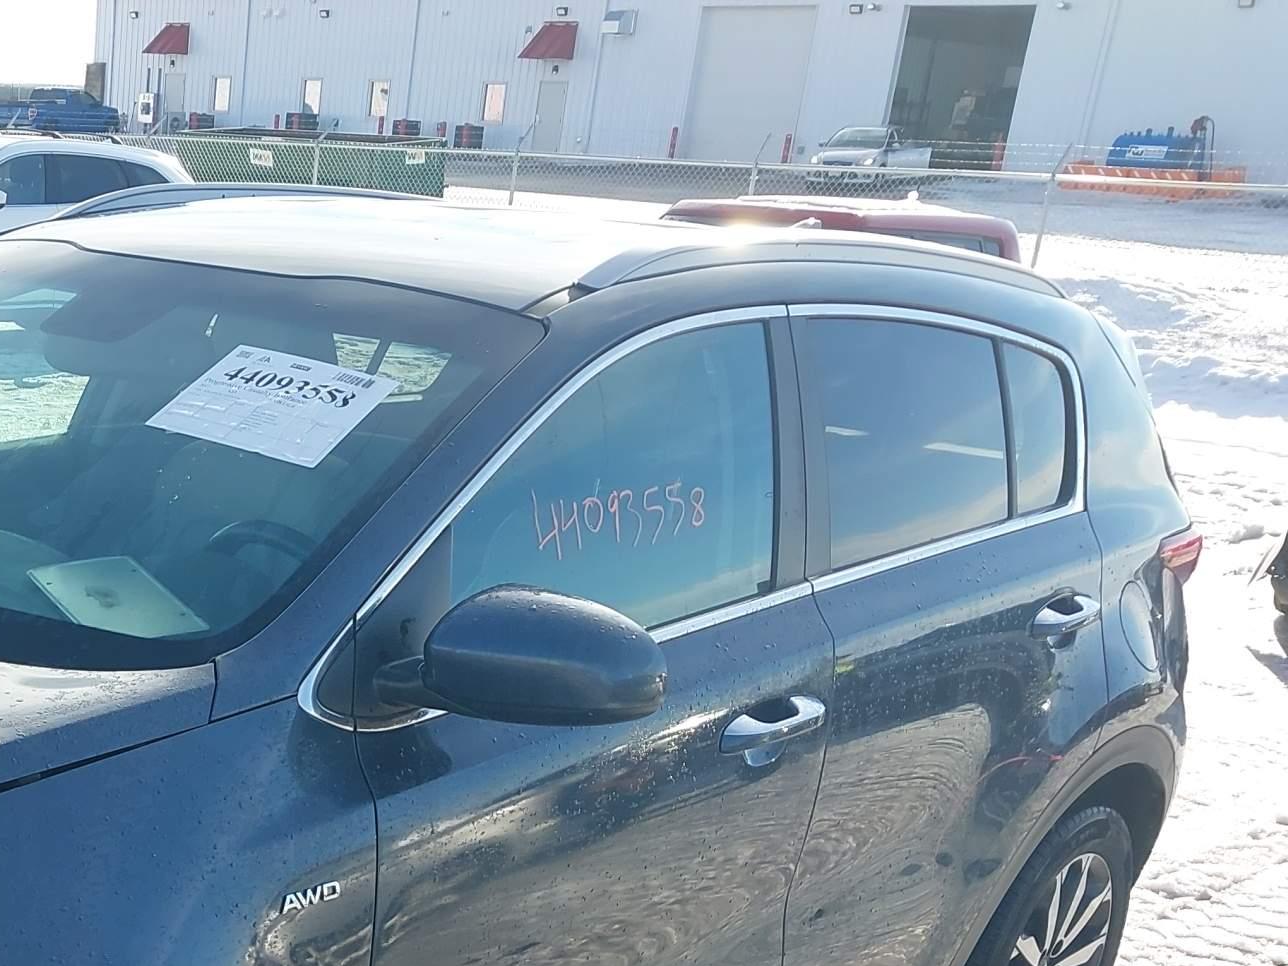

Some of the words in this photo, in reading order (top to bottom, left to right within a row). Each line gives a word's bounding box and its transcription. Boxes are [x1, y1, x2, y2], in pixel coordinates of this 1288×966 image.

[223, 366, 357, 409] 44093558
[530, 477, 705, 561] 44093558
[281, 880, 341, 914] AWD
